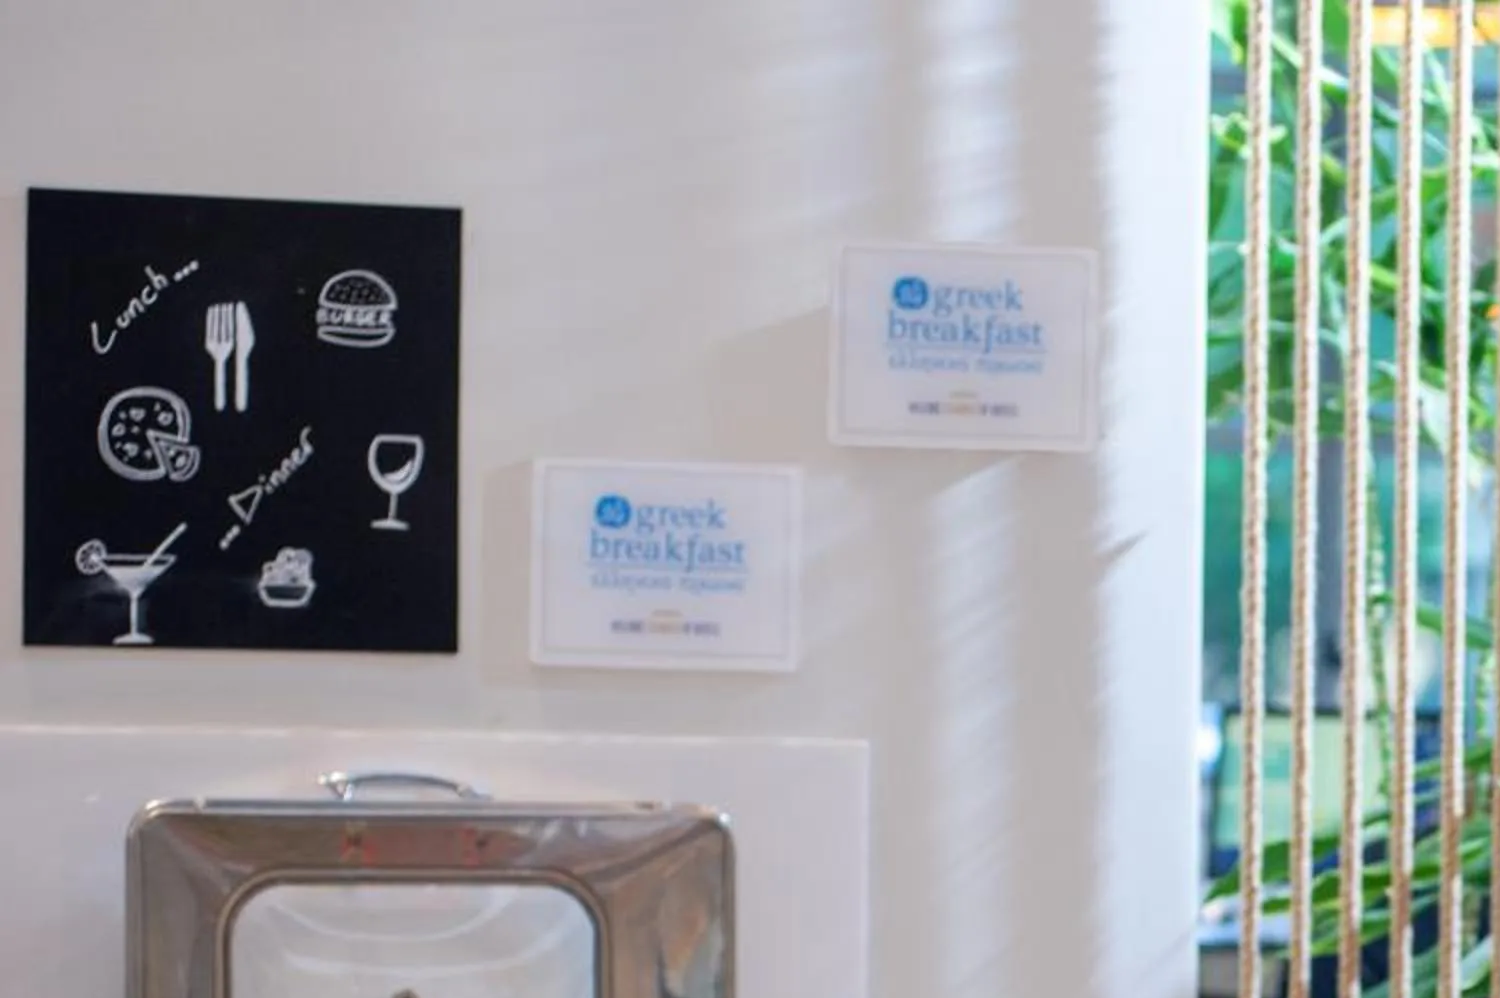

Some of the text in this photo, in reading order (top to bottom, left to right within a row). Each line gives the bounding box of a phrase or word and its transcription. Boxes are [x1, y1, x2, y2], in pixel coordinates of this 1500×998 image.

[933, 280, 1023, 318] greek
[888, 310, 1043, 354] breakfast
[635, 498, 726, 535] greek
[590, 529, 745, 573] breakfast
